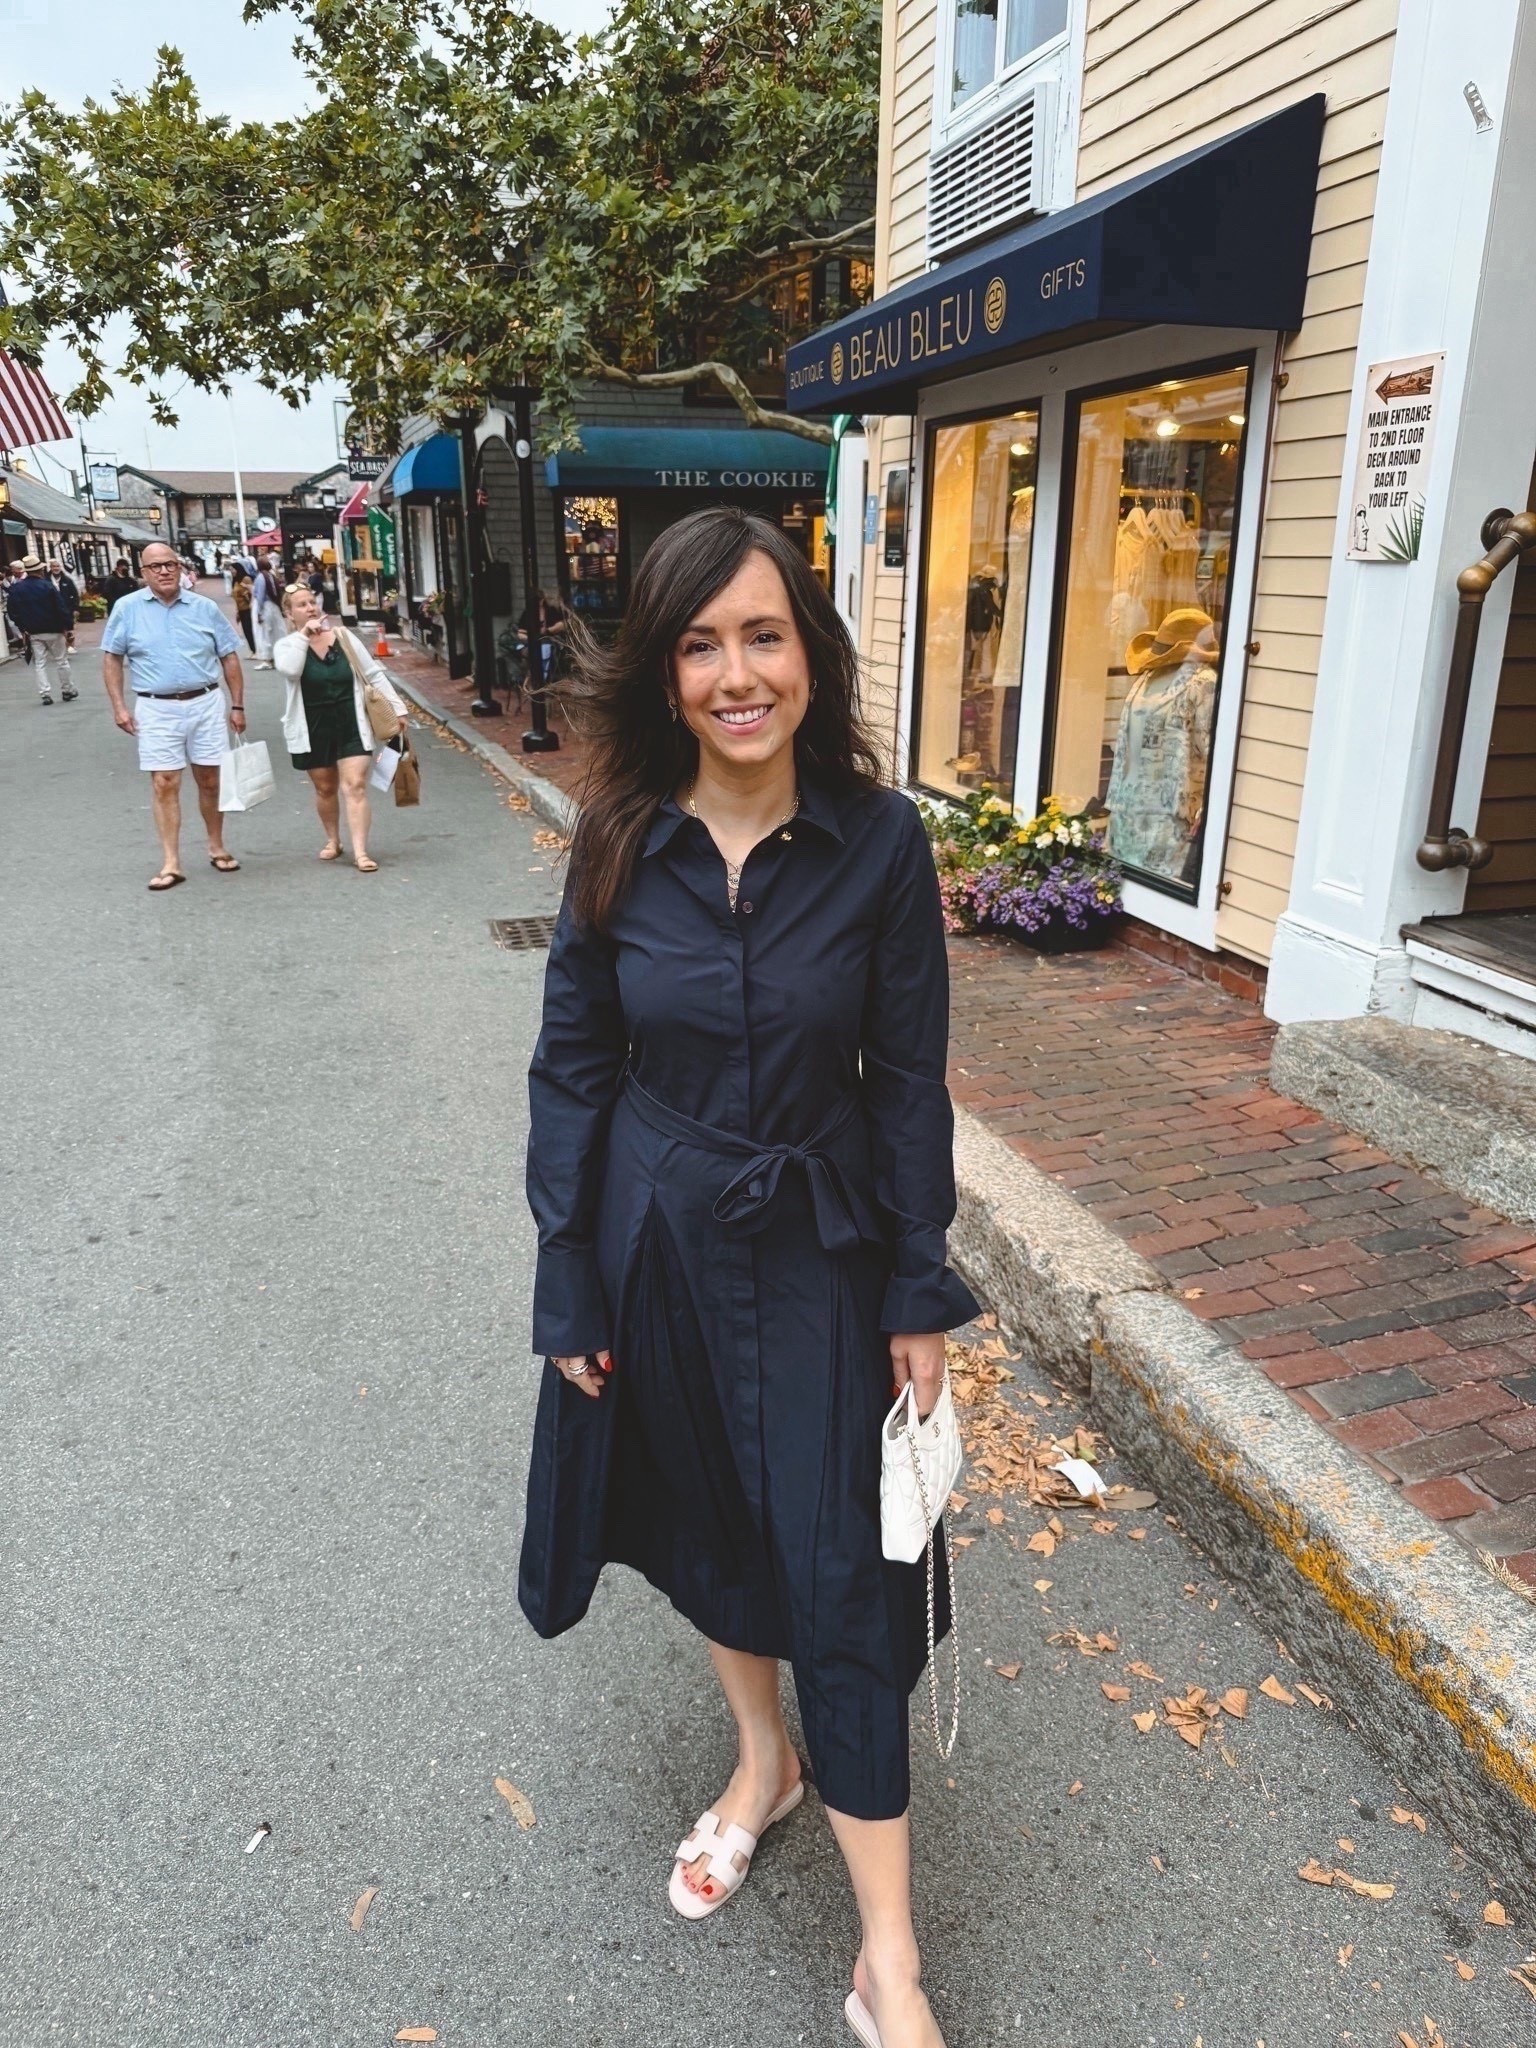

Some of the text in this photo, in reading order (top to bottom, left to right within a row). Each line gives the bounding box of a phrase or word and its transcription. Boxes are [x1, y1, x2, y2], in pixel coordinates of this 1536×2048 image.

[790, 258, 1085, 390] BOUTIQUE BEAU BLEU GIFTS
[1367, 404, 1432, 428] MAIN ENTRANCE
[1369, 427, 1425, 448] TO 2ND FLOOR
[1366, 448, 1421, 468] DECK AROUND
[655, 470, 817, 488] THE COOKIE
[1374, 470, 1407, 488] BACK TO
[1368, 491, 1409, 509] YOUR LEFT
